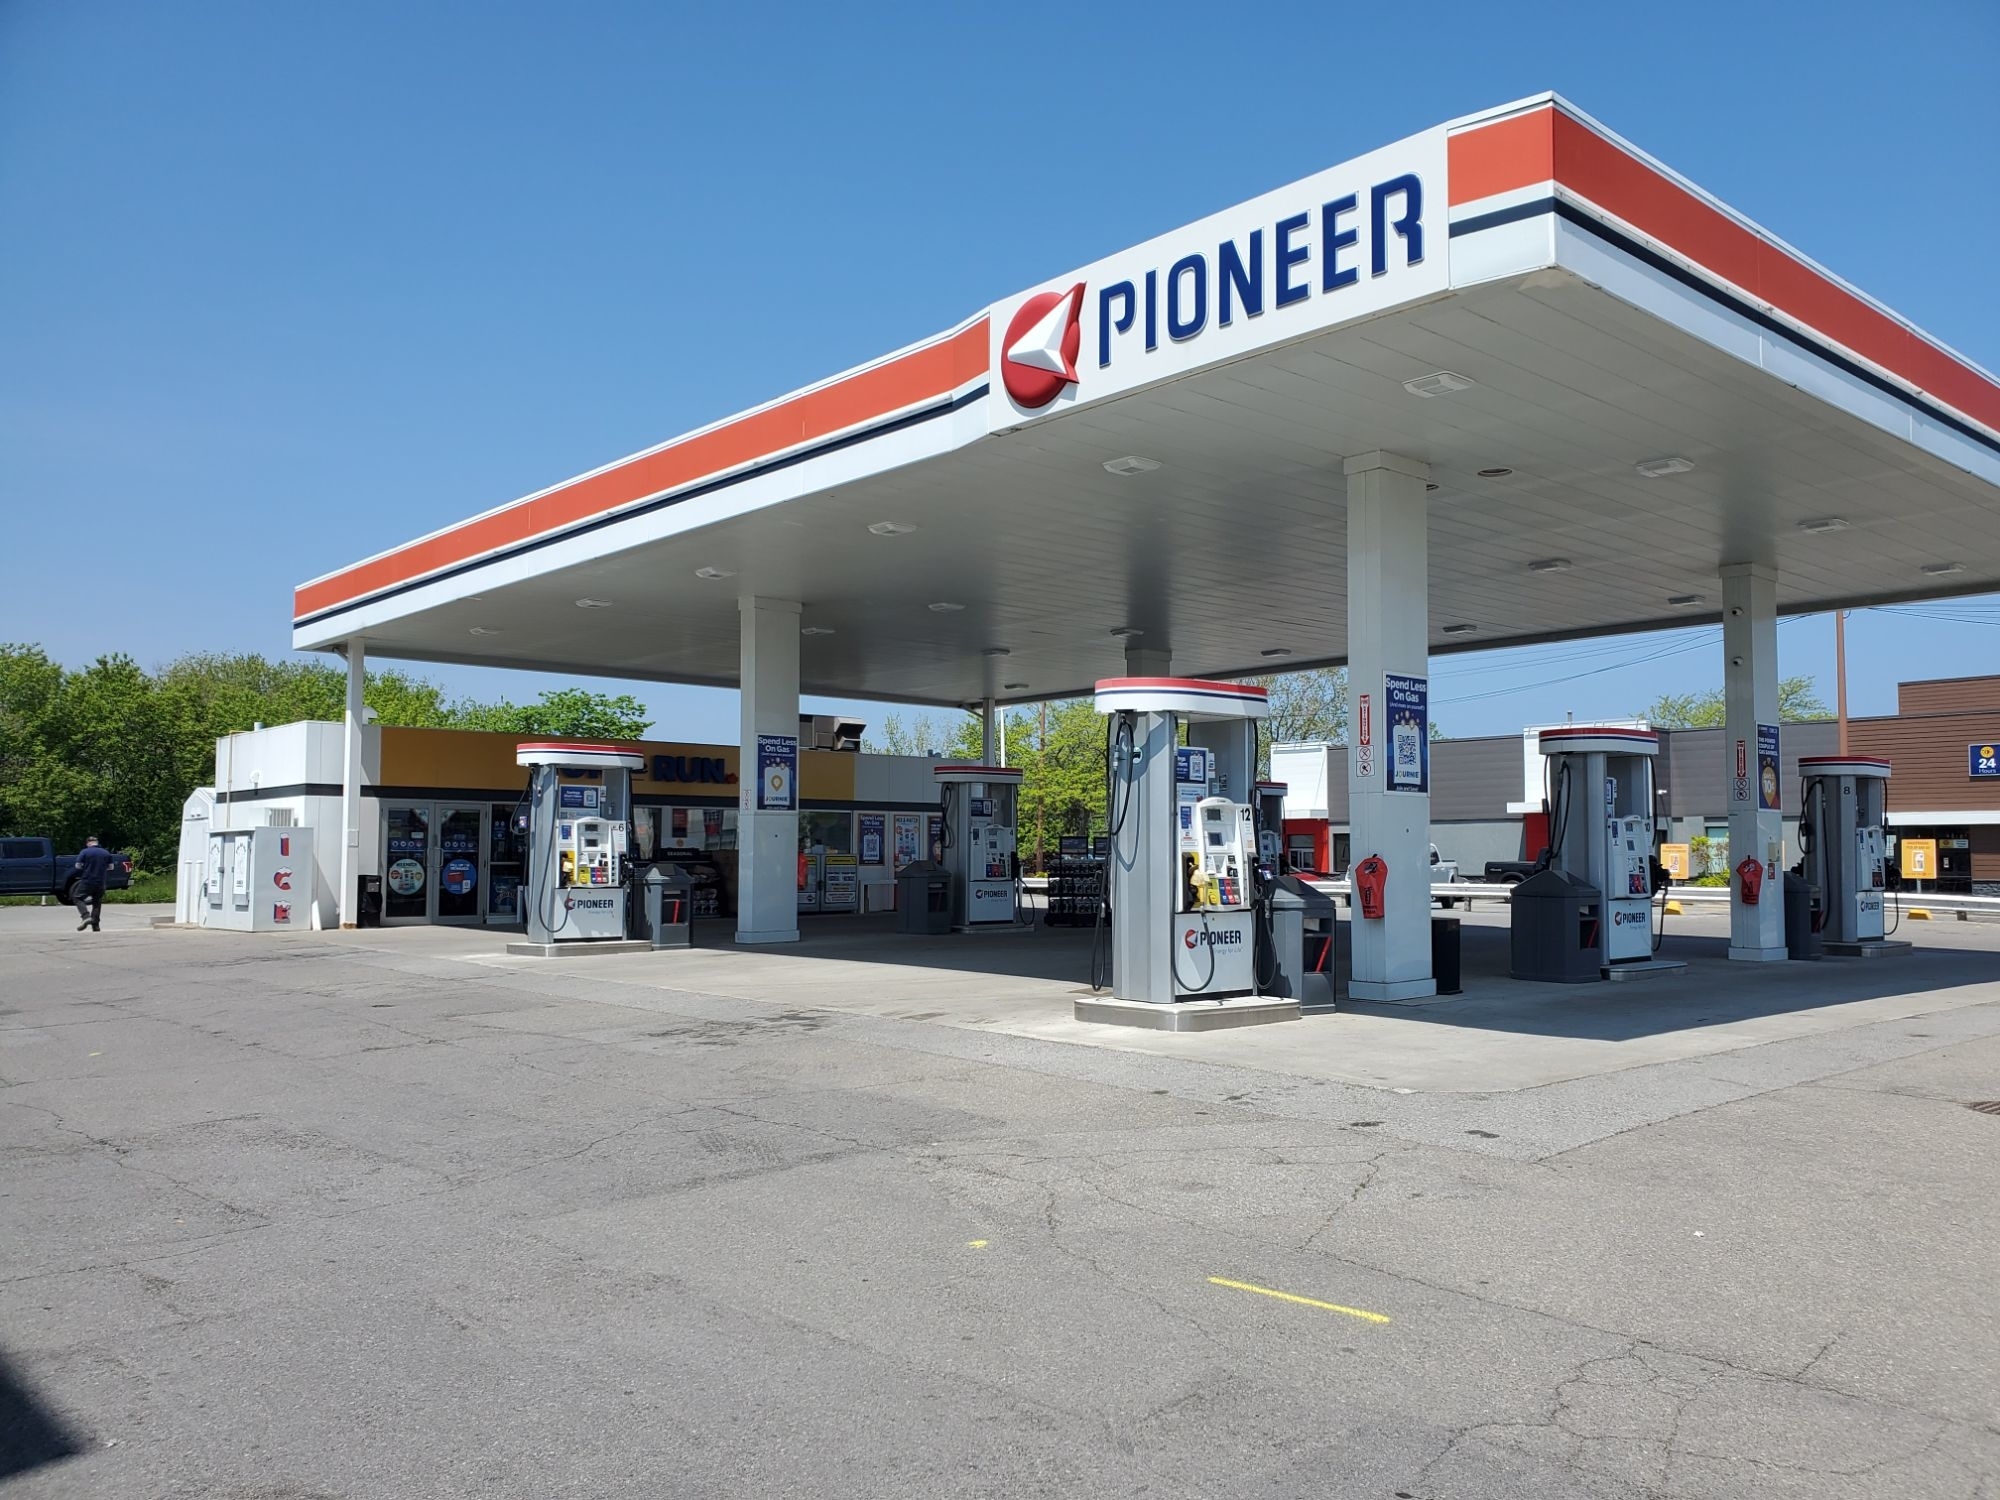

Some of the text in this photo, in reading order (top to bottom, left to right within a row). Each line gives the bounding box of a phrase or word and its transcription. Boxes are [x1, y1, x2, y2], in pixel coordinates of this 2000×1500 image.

[1099, 171, 1425, 369] PIONEER
[1386, 678, 1426, 692] Spend Less
[1393, 690, 1419, 703] On Gas
[759, 737, 780, 745] Spend
[1978, 758, 1997, 769] 24
[653, 755, 725, 784] RUN
[1843, 786, 1851, 796] 8
[1240, 808, 1251, 821] 12
[618, 823, 625, 832] 6
[1645, 823, 1650, 832] 10
[577, 899, 614, 909] PIONEER
[1622, 912, 1646, 924] PIONEER
